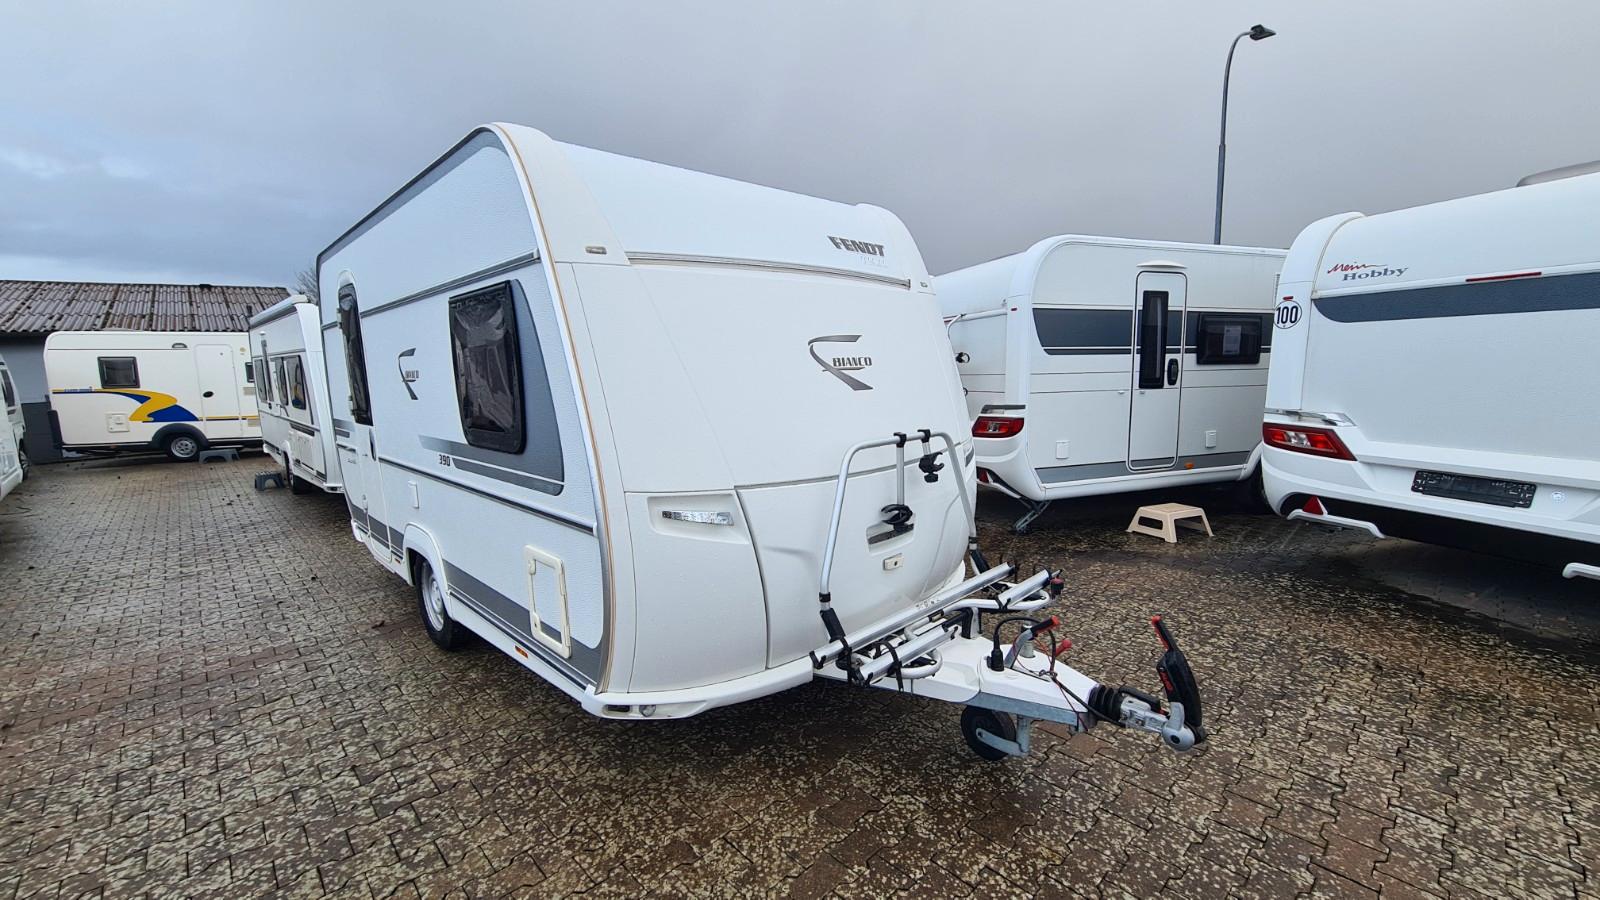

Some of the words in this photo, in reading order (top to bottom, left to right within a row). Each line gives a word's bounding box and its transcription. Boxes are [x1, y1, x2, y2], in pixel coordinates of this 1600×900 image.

[827, 235, 885, 257] FENDT
[1327, 261, 1386, 274] Mein
[1343, 267, 1408, 281] Hobby
[1275, 305, 1299, 325] 100
[832, 356, 872, 367] BIANCO
[438, 453, 451, 467] 390
